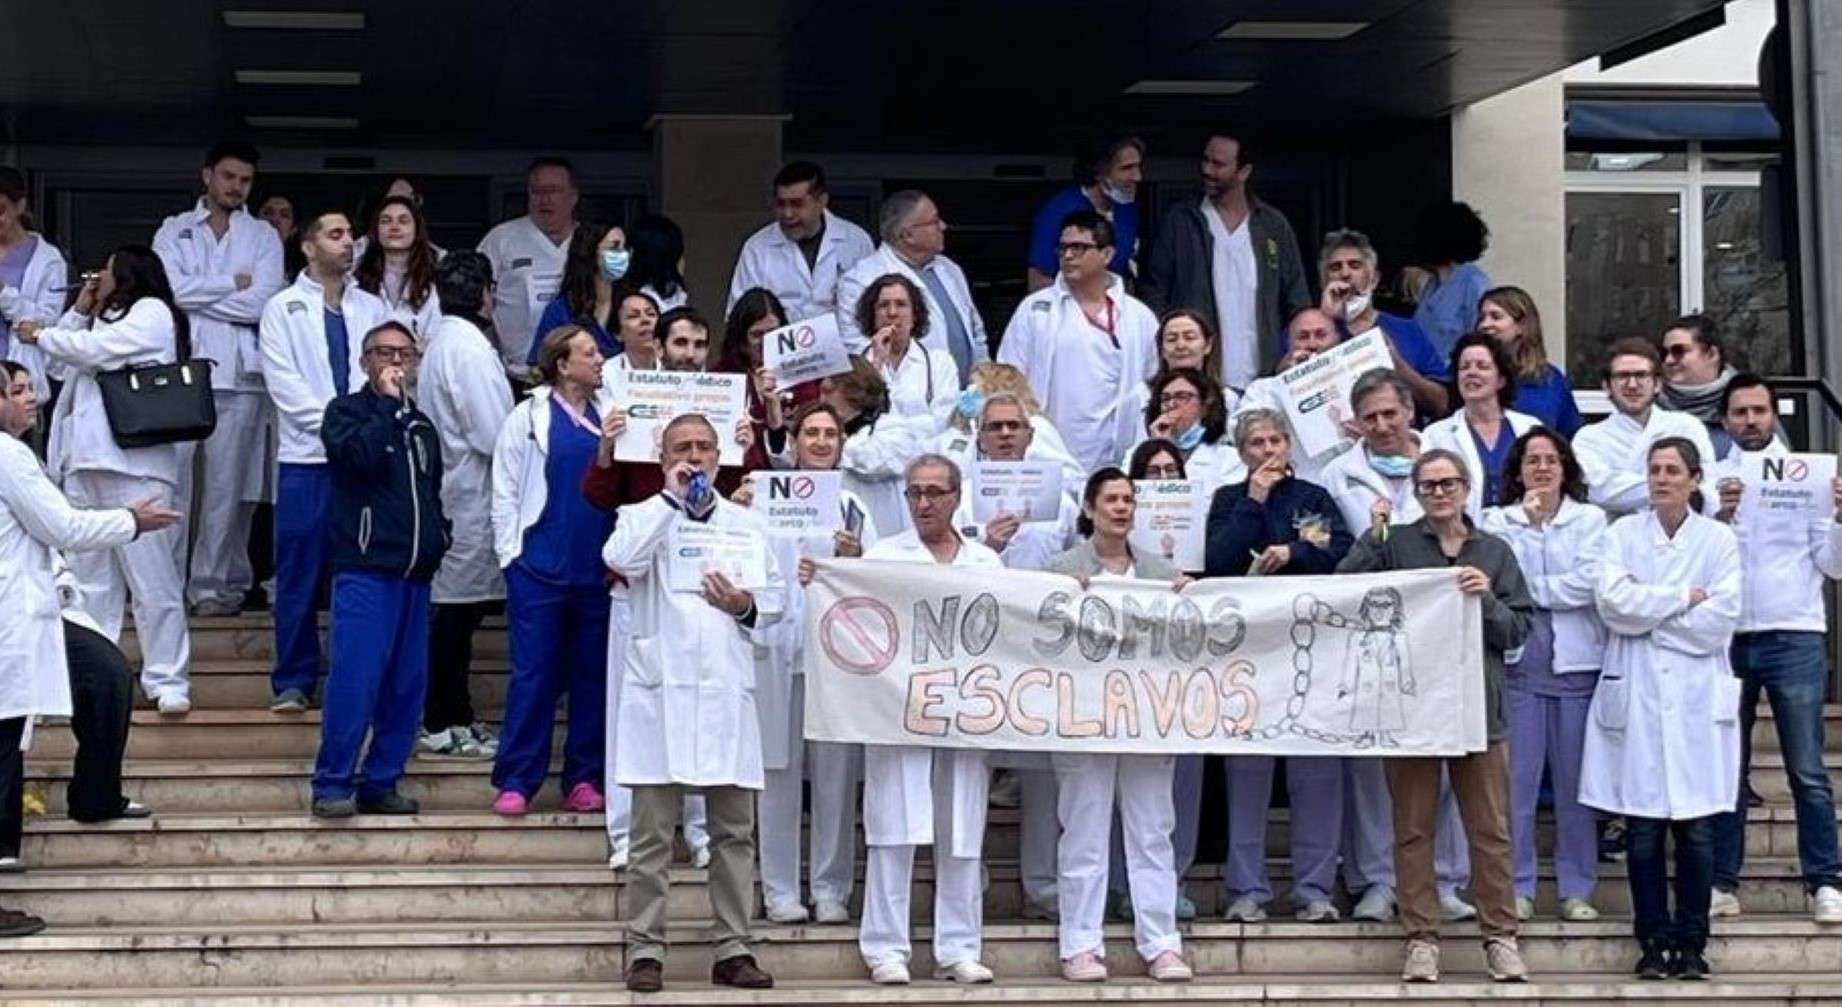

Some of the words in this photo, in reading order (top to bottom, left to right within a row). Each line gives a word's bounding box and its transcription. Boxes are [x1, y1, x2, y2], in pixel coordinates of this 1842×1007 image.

[627, 372, 682, 386] Estatuto
[769, 506, 818, 517] Estatuto
[911, 592, 1001, 664] NO
[1031, 591, 1247, 662] SOMOS
[903, 659, 1259, 740] ESCLAVOS
